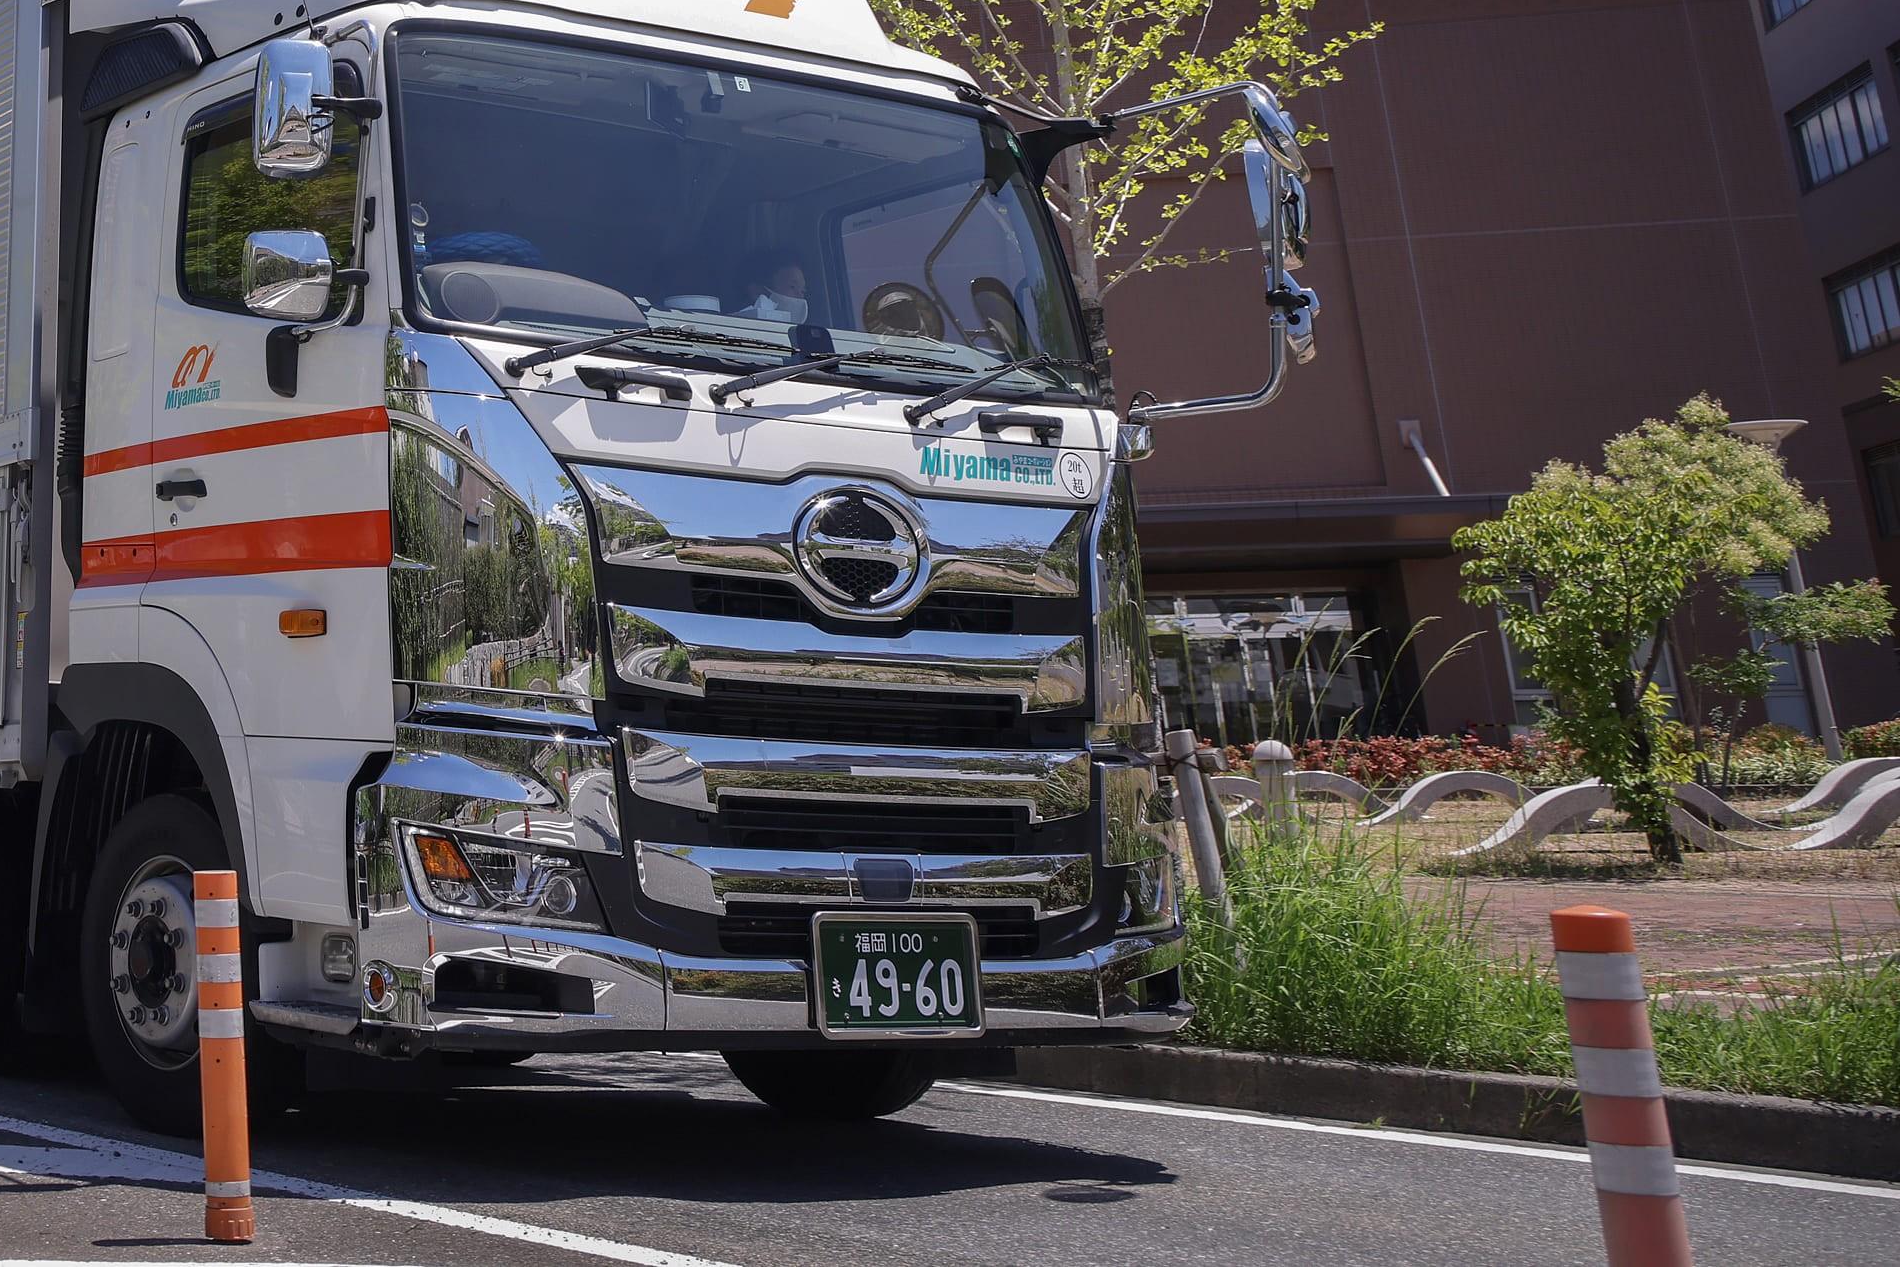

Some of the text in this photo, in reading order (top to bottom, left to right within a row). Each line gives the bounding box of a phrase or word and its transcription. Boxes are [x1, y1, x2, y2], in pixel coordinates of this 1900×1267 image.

[164, 388, 203, 410] Miyama
[919, 446, 1056, 486] Miyama CO.,LTD.
[1067, 460, 1082, 474] 20t
[1072, 477, 1085, 494] 超
[850, 959, 964, 1017] 49-60
